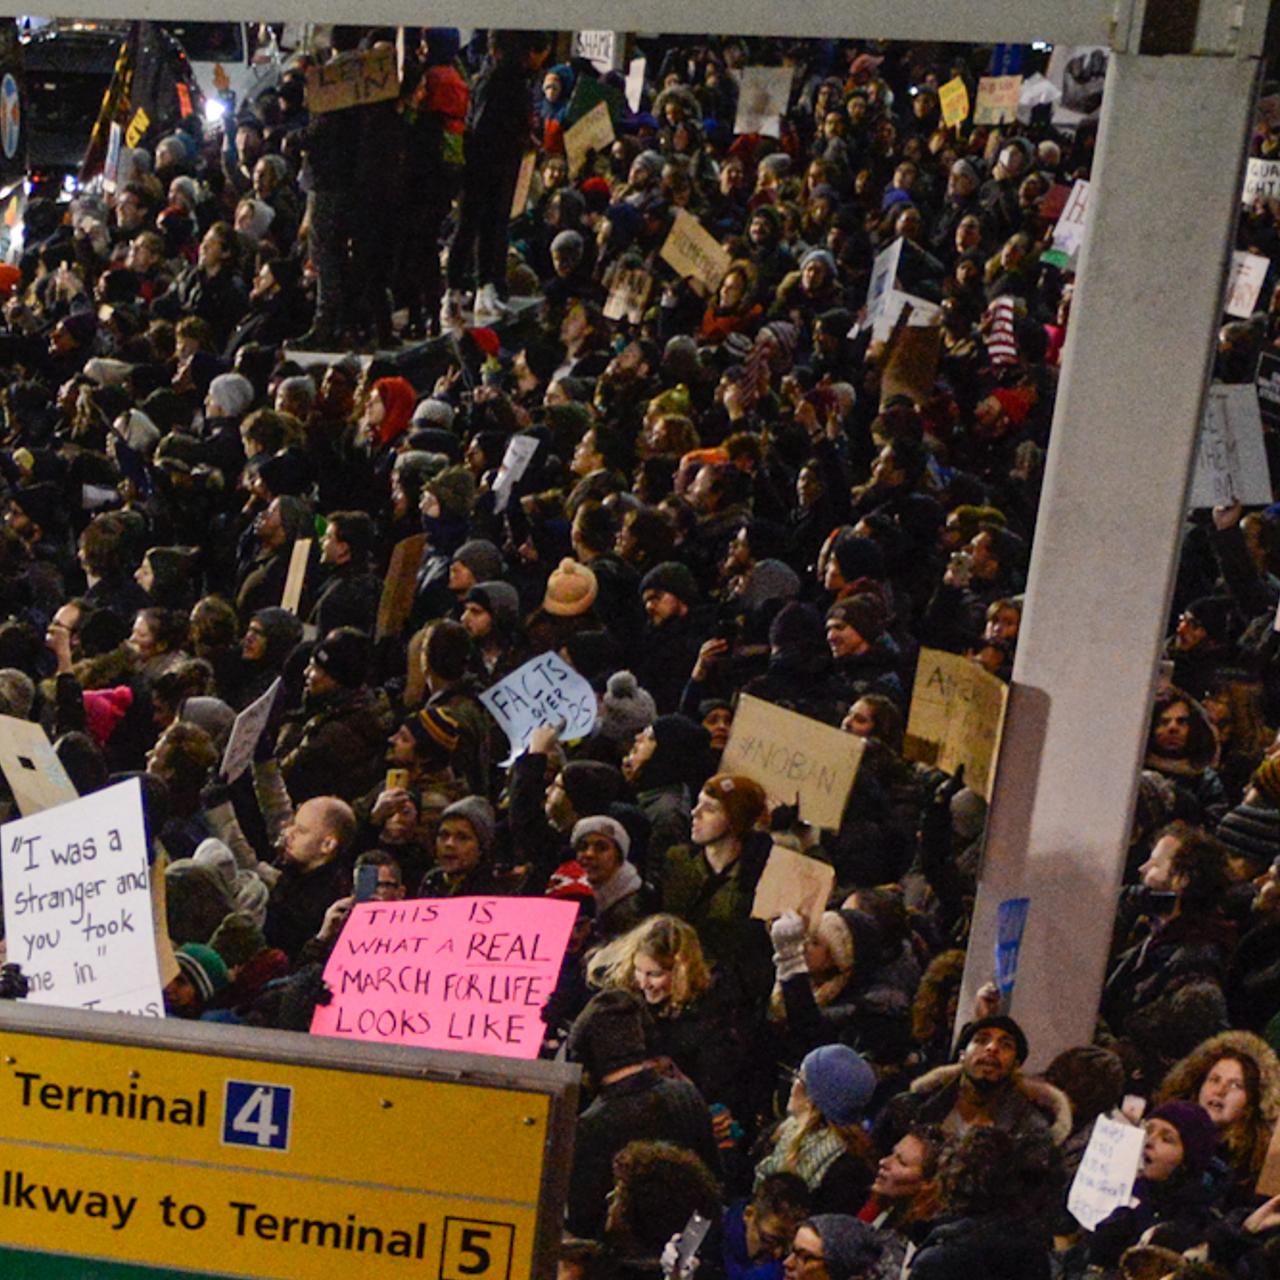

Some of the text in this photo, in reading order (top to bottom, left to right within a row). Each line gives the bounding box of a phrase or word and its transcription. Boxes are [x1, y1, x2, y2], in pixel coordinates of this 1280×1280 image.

[491, 658, 568, 721] FACTS
[52, 838, 98, 865] was
[110, 828, 124, 852] a
[14, 856, 149, 925] stranger and
[368, 900, 495, 926] THIS IS
[23, 910, 136, 961] you took
[348, 932, 552, 962] WHAT A REAL
[444, 973, 482, 1005] FOR
[335, 1006, 525, 1044] LOOKS LIKE
[12, 1068, 280, 1146] Terminal 4
[159, 1196, 207, 1234] to
[228, 1199, 427, 1261] Terminal
[453, 1229, 493, 1278] 5
